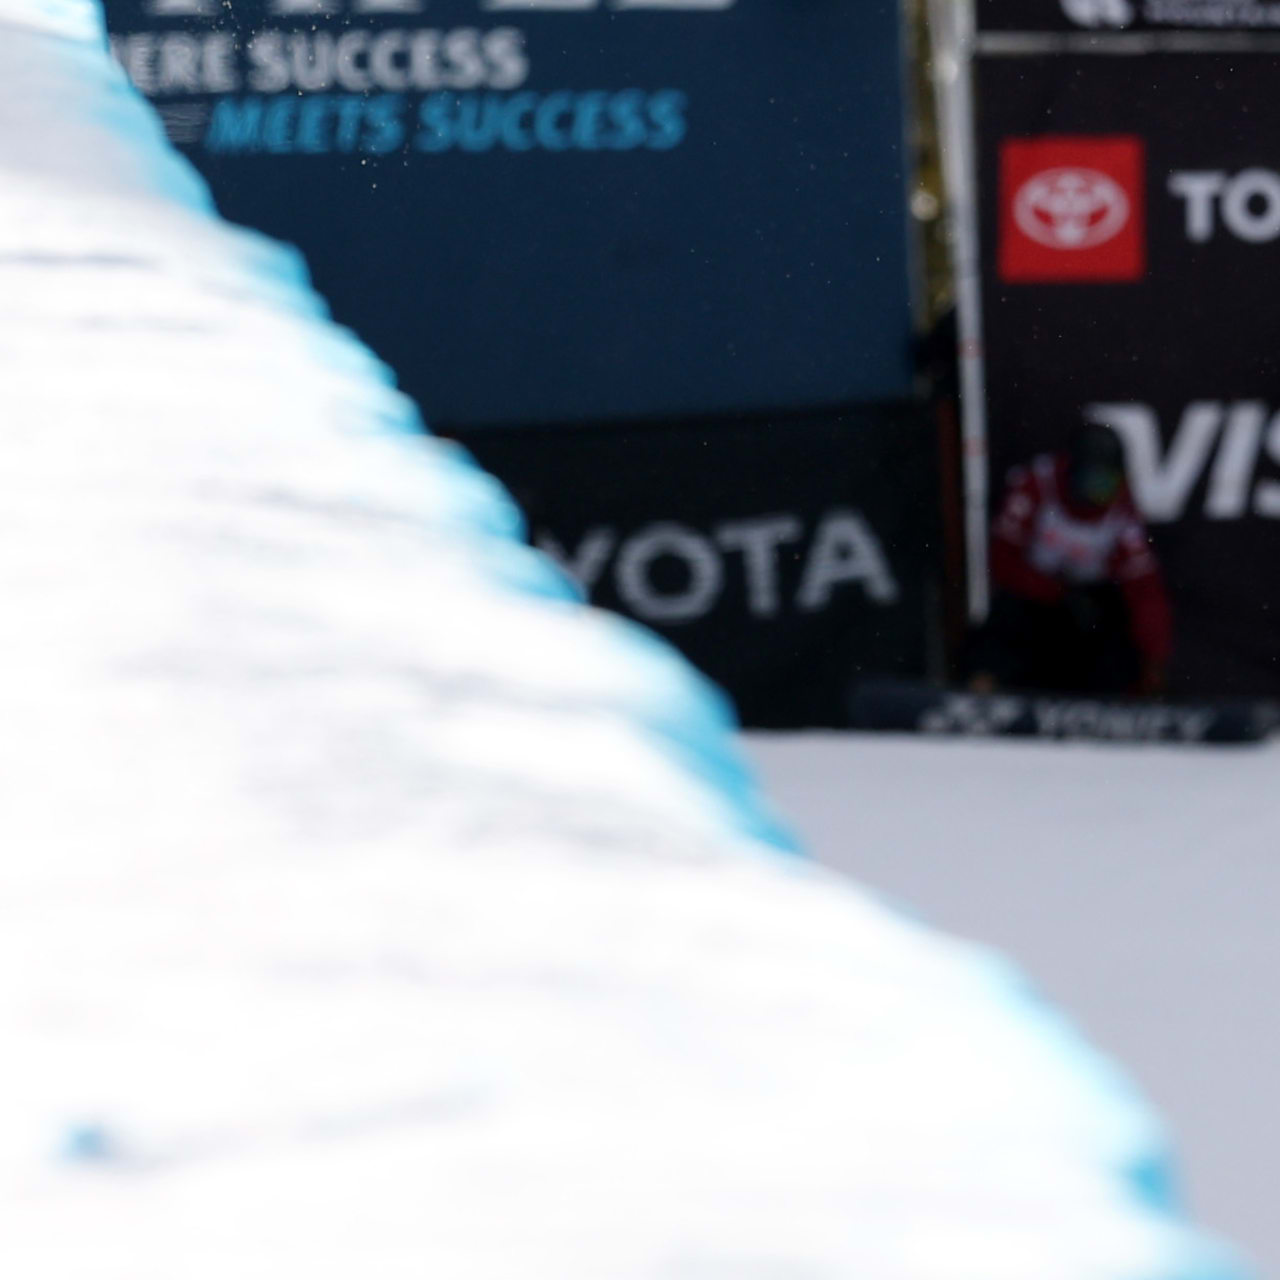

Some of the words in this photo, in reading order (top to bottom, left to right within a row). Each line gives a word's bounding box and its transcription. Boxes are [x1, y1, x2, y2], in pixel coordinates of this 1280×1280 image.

[108, 31, 238, 93] ERE
[246, 28, 529, 93] SUCCESS
[206, 93, 404, 154] MEETS
[418, 89, 687, 152] SUCCESS
[532, 512, 899, 622] YOTA
